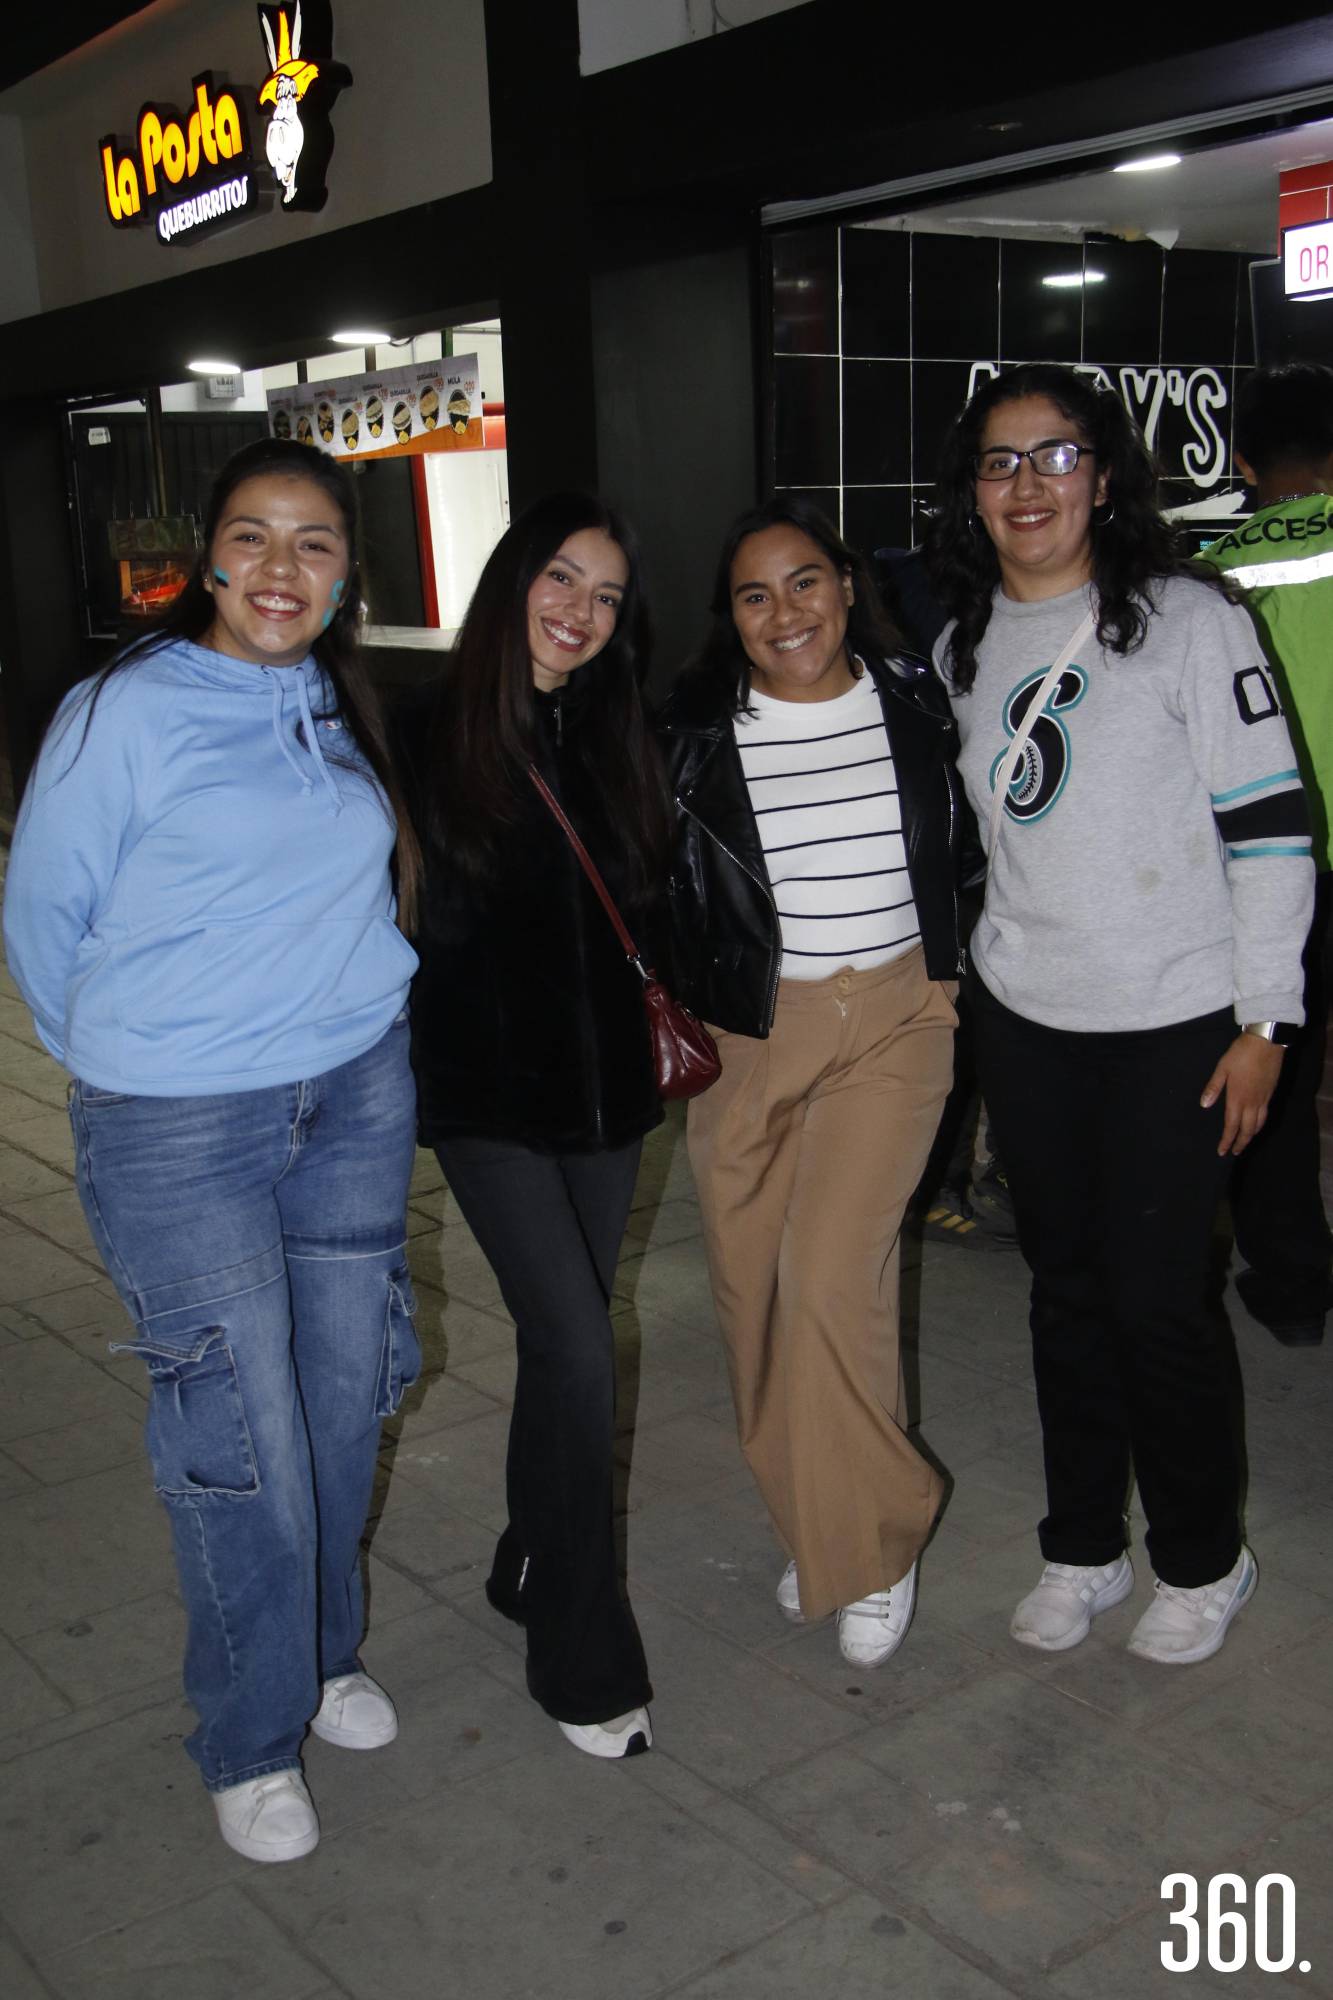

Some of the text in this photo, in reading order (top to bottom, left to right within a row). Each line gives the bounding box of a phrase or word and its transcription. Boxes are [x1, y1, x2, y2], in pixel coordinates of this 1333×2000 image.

[103, 84, 243, 220] la Posta
[158, 176, 248, 241] QUEBURRITOS
